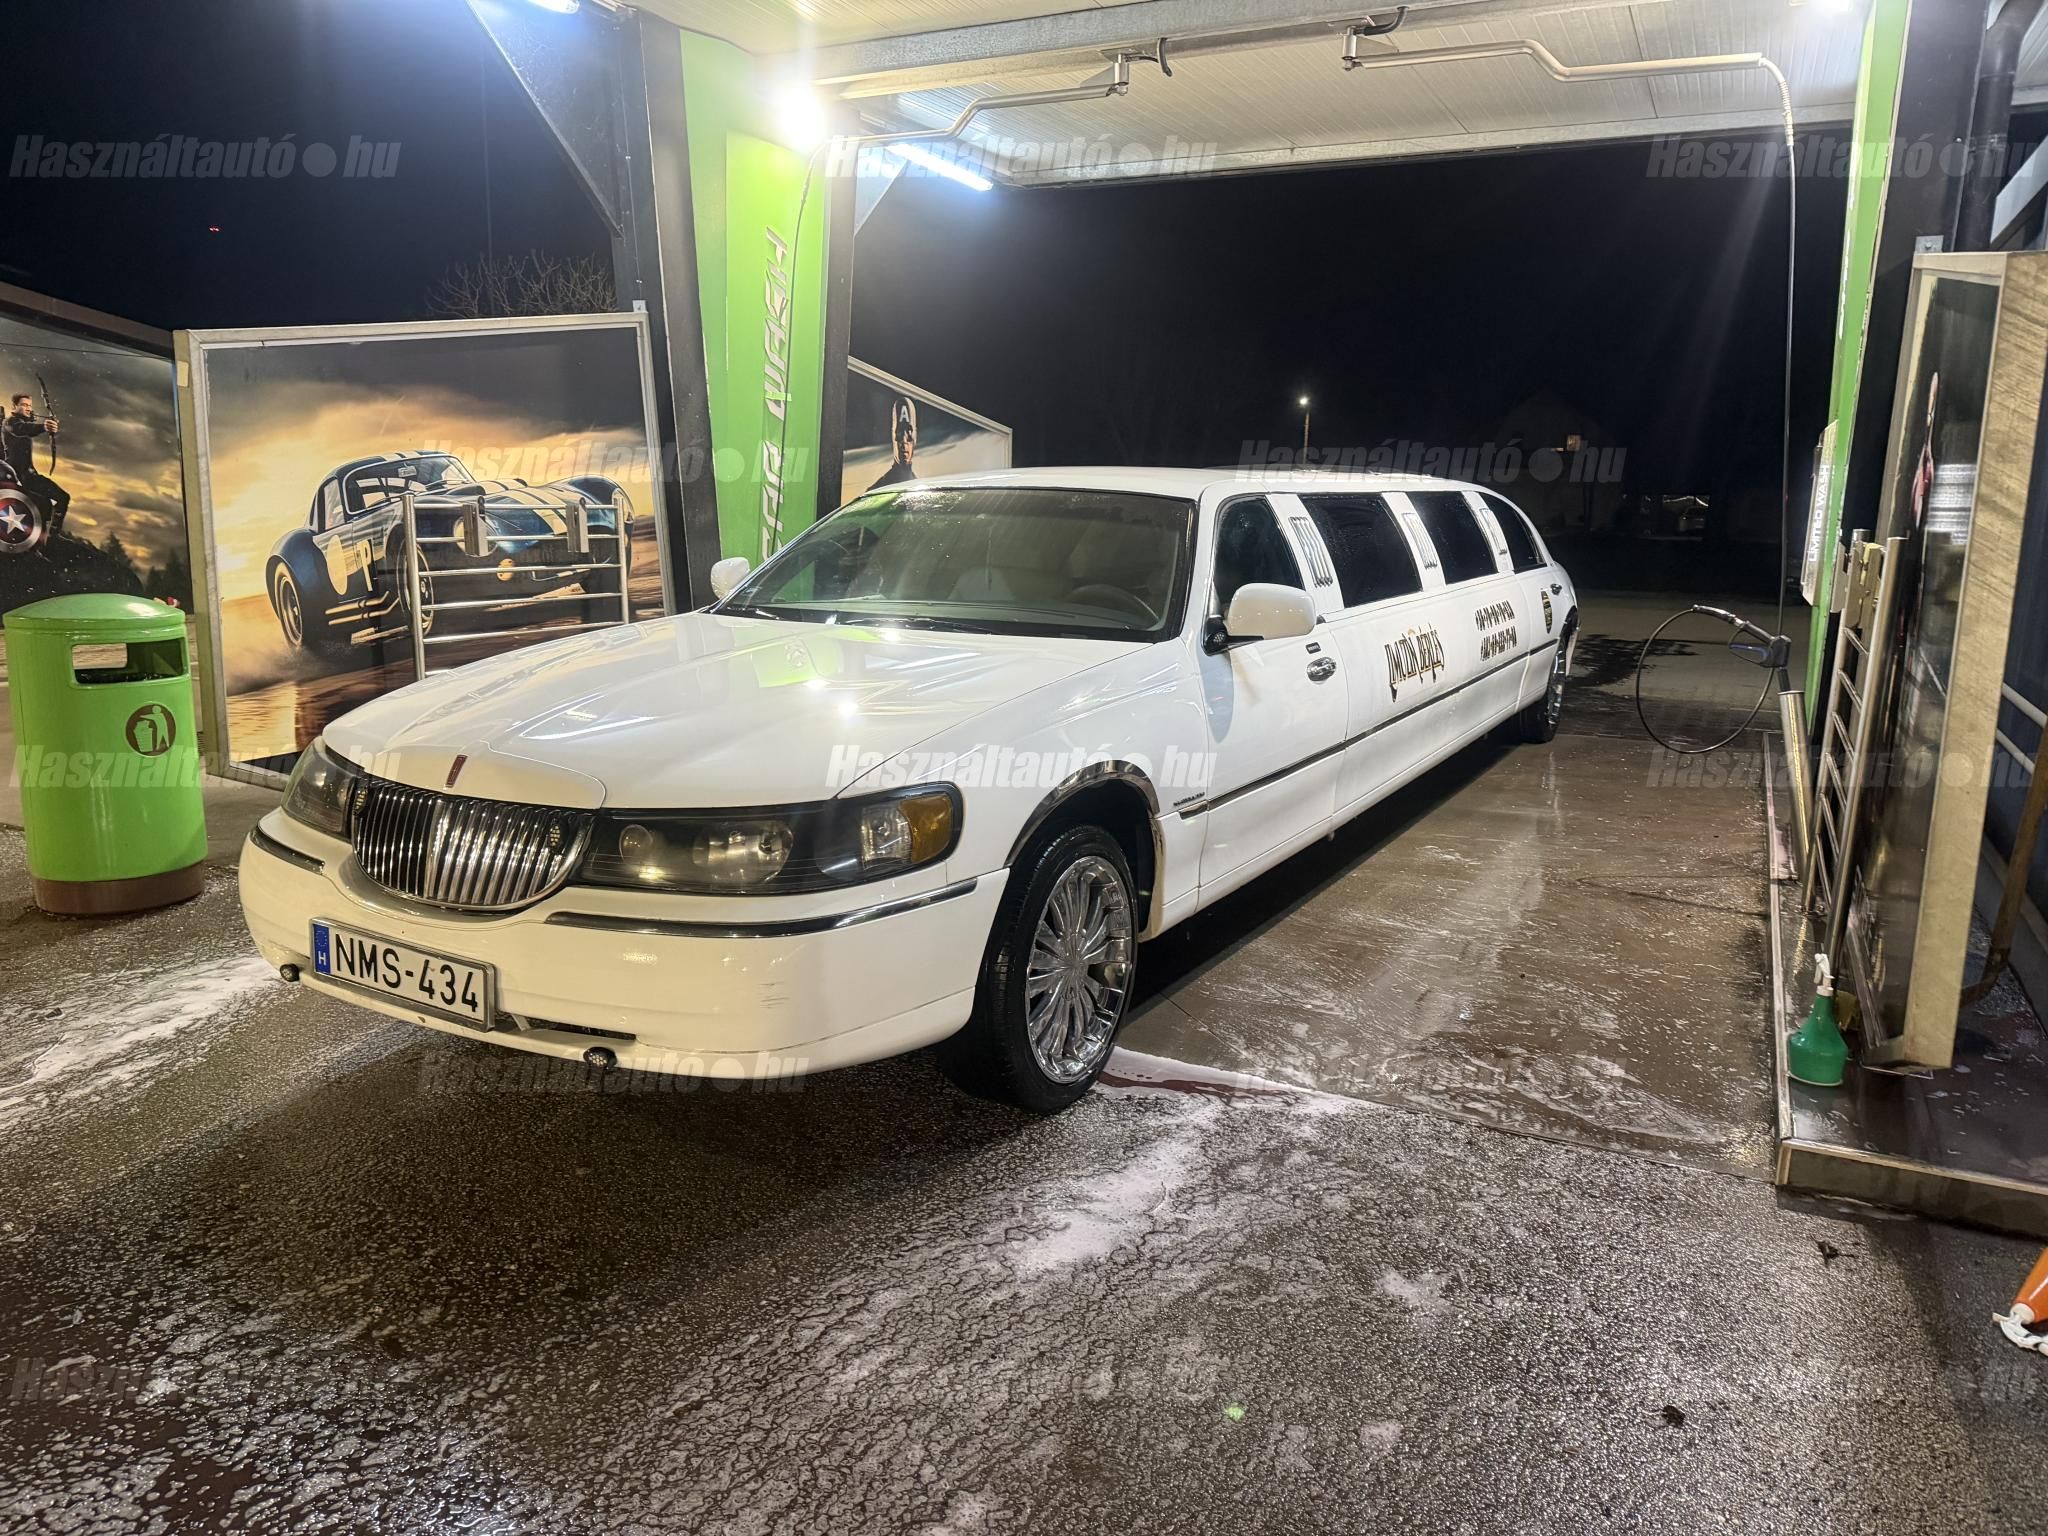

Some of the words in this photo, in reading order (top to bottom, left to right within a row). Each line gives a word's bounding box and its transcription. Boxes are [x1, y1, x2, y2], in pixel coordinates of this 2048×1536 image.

[899, 405, 910, 422] A
[1808, 509, 1823, 562] LIMITED
[1816, 464, 1831, 507] WASH
[318, 951, 327, 966] H
[335, 933, 478, 1013] NMS-434
